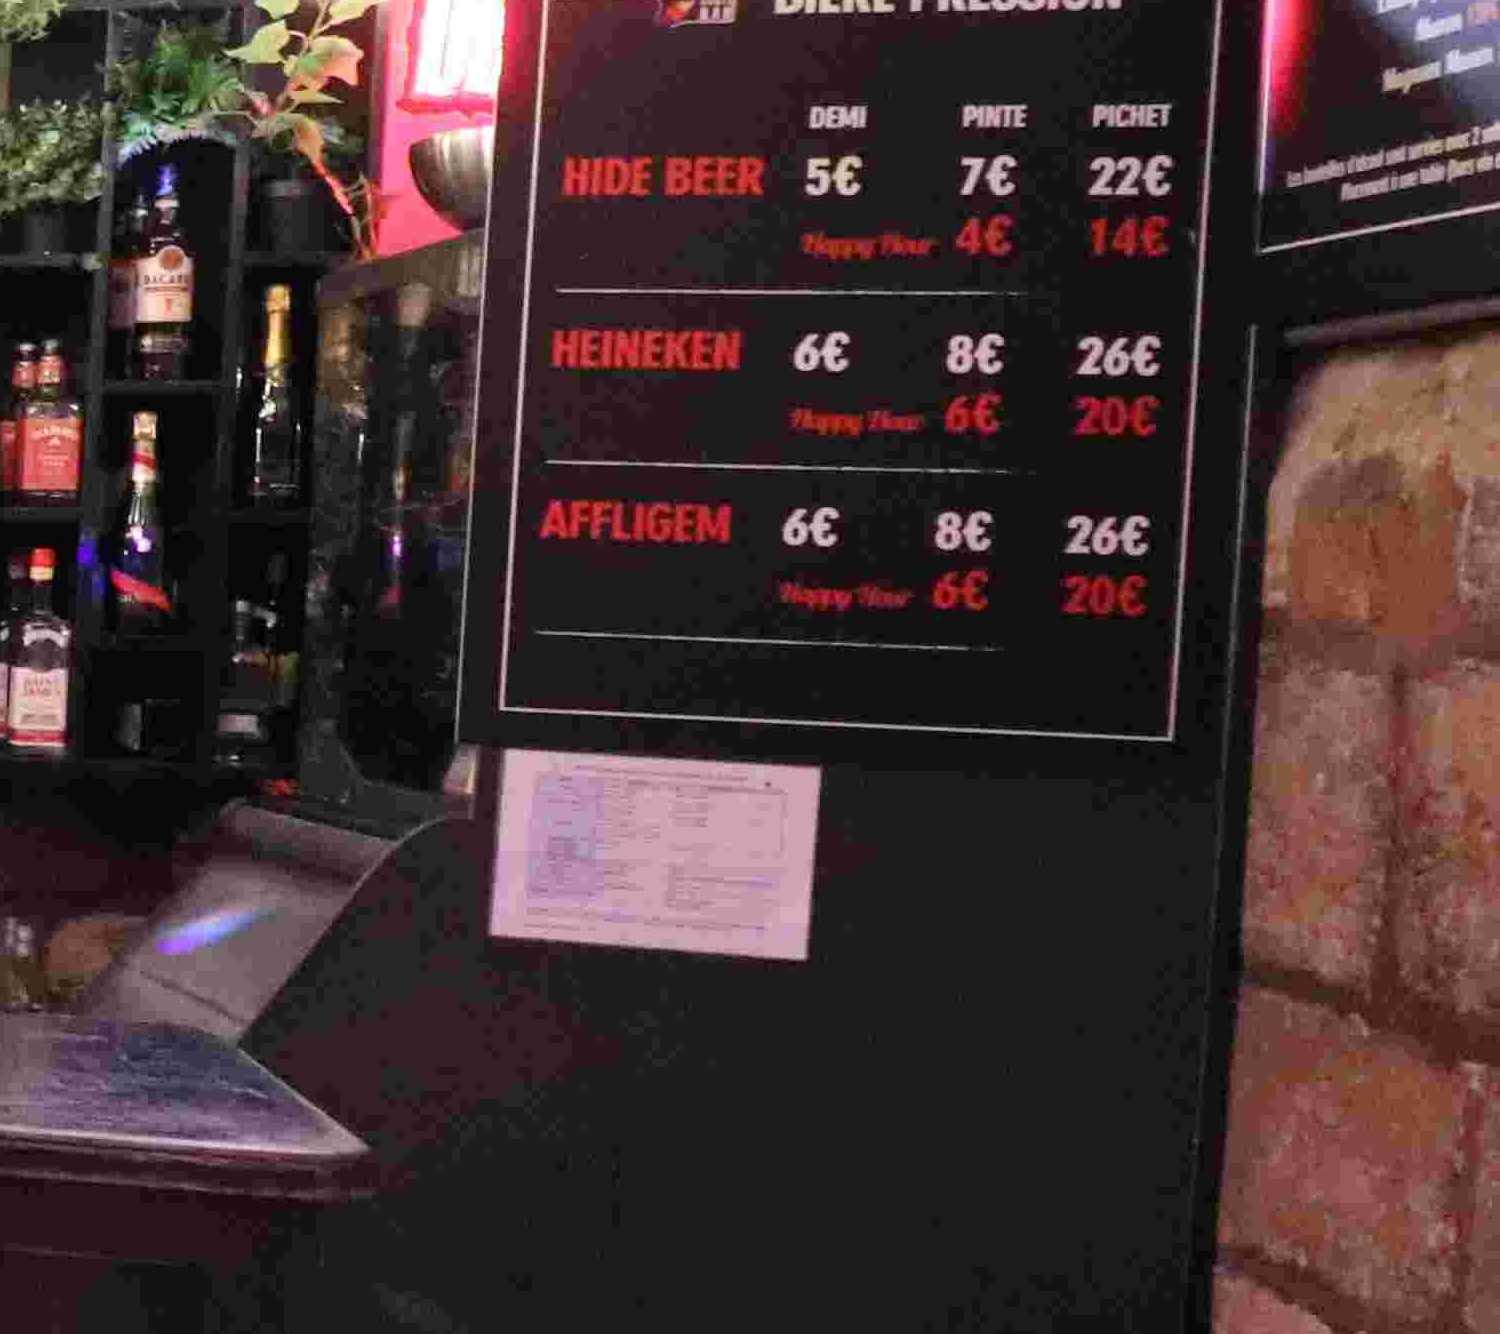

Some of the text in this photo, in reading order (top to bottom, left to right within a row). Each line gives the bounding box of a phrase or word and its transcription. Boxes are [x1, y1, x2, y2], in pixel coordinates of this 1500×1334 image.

[809, 103, 1172, 130] DEMI PINTE PICHET
[562, 155, 1173, 197] HIDE BEER 5€ 7€ 22€
[803, 232, 875, 262] Happy
[955, 214, 1013, 257] 4€
[1087, 215, 1171, 257] 14€
[551, 329, 1162, 377] HEINEKEN 6€ 8€ 26€
[944, 393, 1003, 435] 6€
[1074, 395, 1160, 437] 20€
[539, 498, 1150, 556] AFFLIGEM 6€ 8€ 26€
[932, 570, 989, 611] 6€
[1061, 574, 1147, 617] 20€
